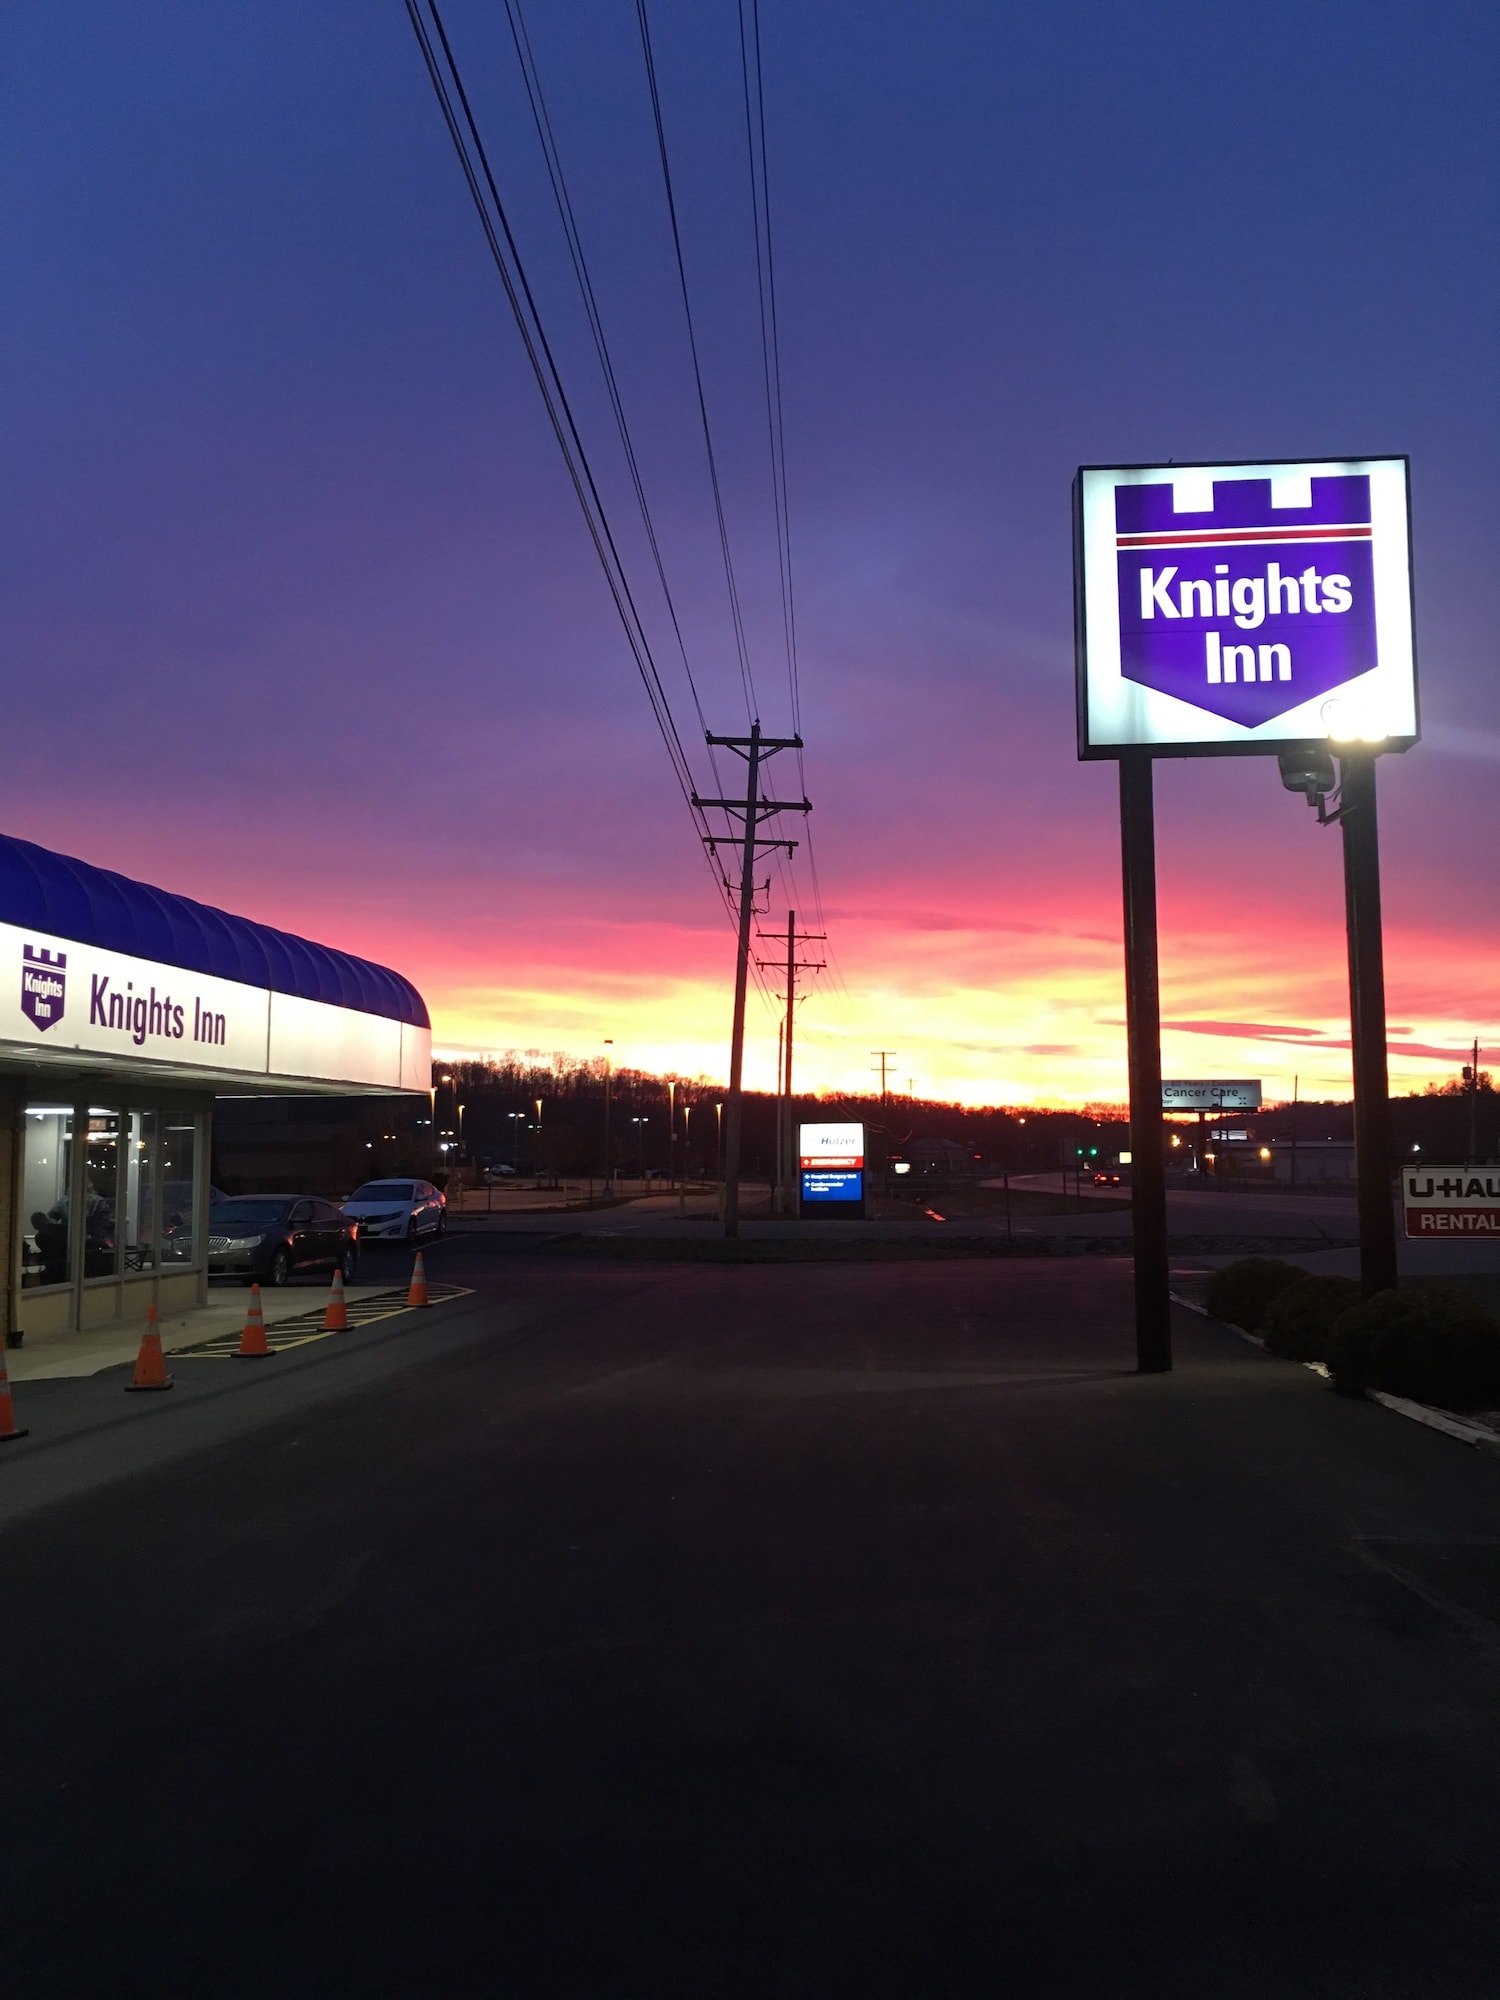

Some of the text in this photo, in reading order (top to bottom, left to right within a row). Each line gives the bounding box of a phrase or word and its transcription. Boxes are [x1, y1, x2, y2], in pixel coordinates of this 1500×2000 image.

[1139, 562, 1353, 629] Knights
[1205, 631, 1292, 684] Inn
[25, 972, 63, 999] Knights
[35, 996, 51, 1018] Inn
[90, 973, 226, 1046] Knights Inn
[1164, 1088, 1239, 1097] Cancer Care
[821, 1137, 855, 1145] Holzer
[811, 1158, 856, 1166] EMERGENCY
